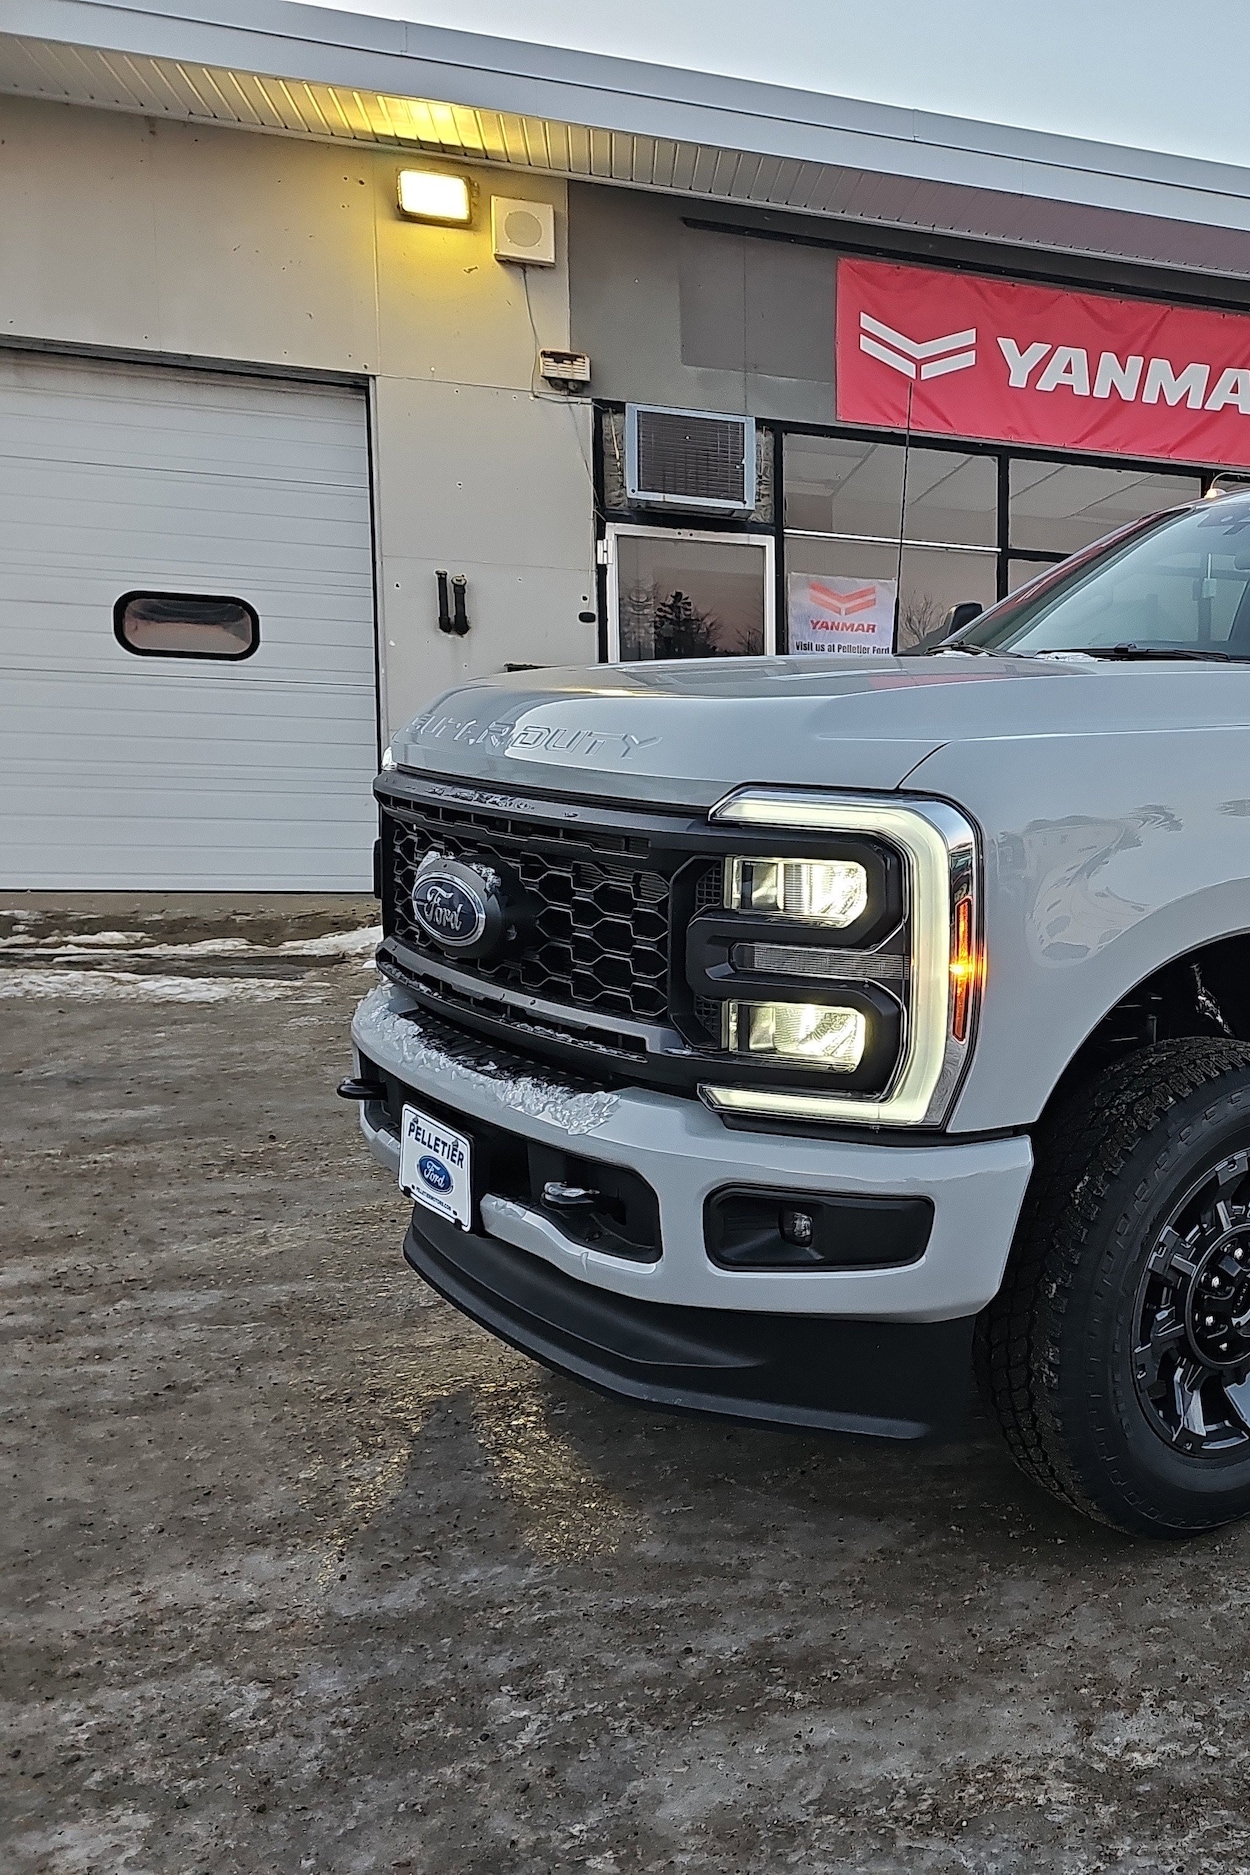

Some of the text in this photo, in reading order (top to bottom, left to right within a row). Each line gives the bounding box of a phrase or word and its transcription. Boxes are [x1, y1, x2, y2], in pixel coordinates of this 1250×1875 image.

[809, 619, 877, 633] YANMAR
[796, 641, 890, 654] Visit us at Pelletier Ford
[511, 724, 664, 760] DUTY
[424, 885, 464, 931] Ford
[407, 1121, 465, 1170] PELLETIER
[423, 1160, 446, 1189] Ford
